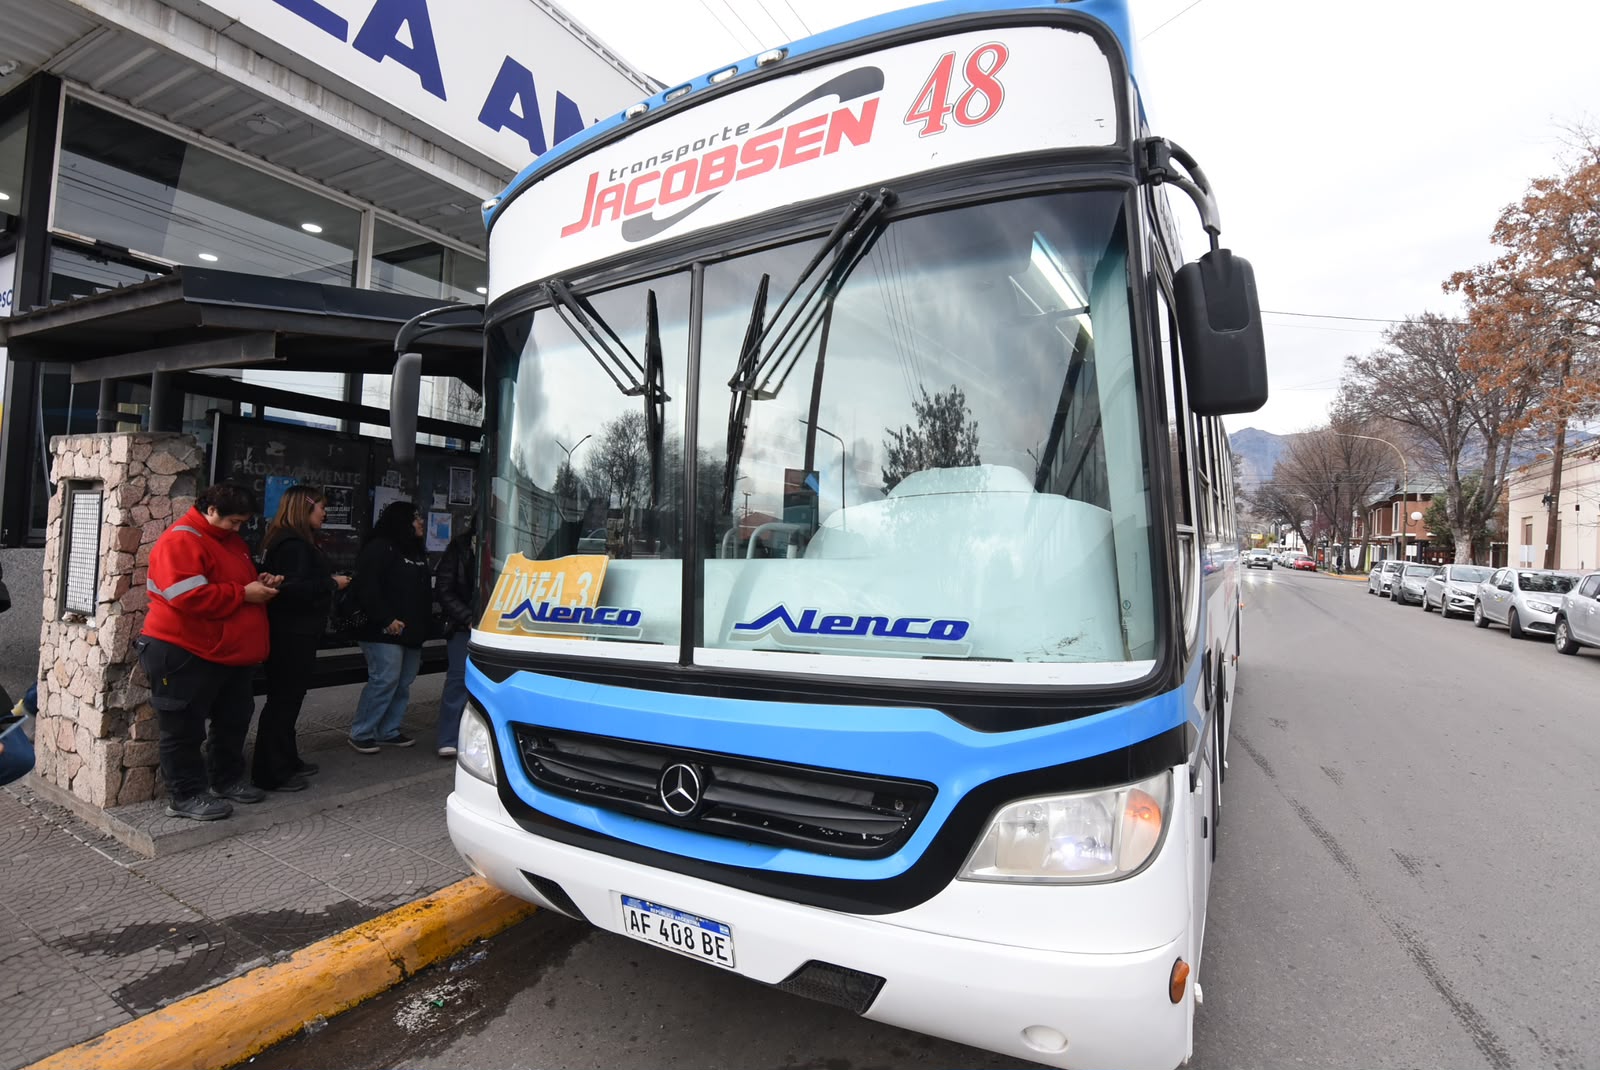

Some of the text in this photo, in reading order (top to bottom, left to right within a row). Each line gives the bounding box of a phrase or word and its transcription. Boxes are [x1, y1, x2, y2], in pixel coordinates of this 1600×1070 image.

[903, 40, 1010, 138] 48
[560, 97, 881, 239] JACOBSEN
[608, 122, 750, 183] transporte
[501, 598, 642, 627] Alenco
[571, 571, 593, 609] 3
[733, 603, 970, 642] Alenco
[630, 909, 728, 961] AF 408 BE
